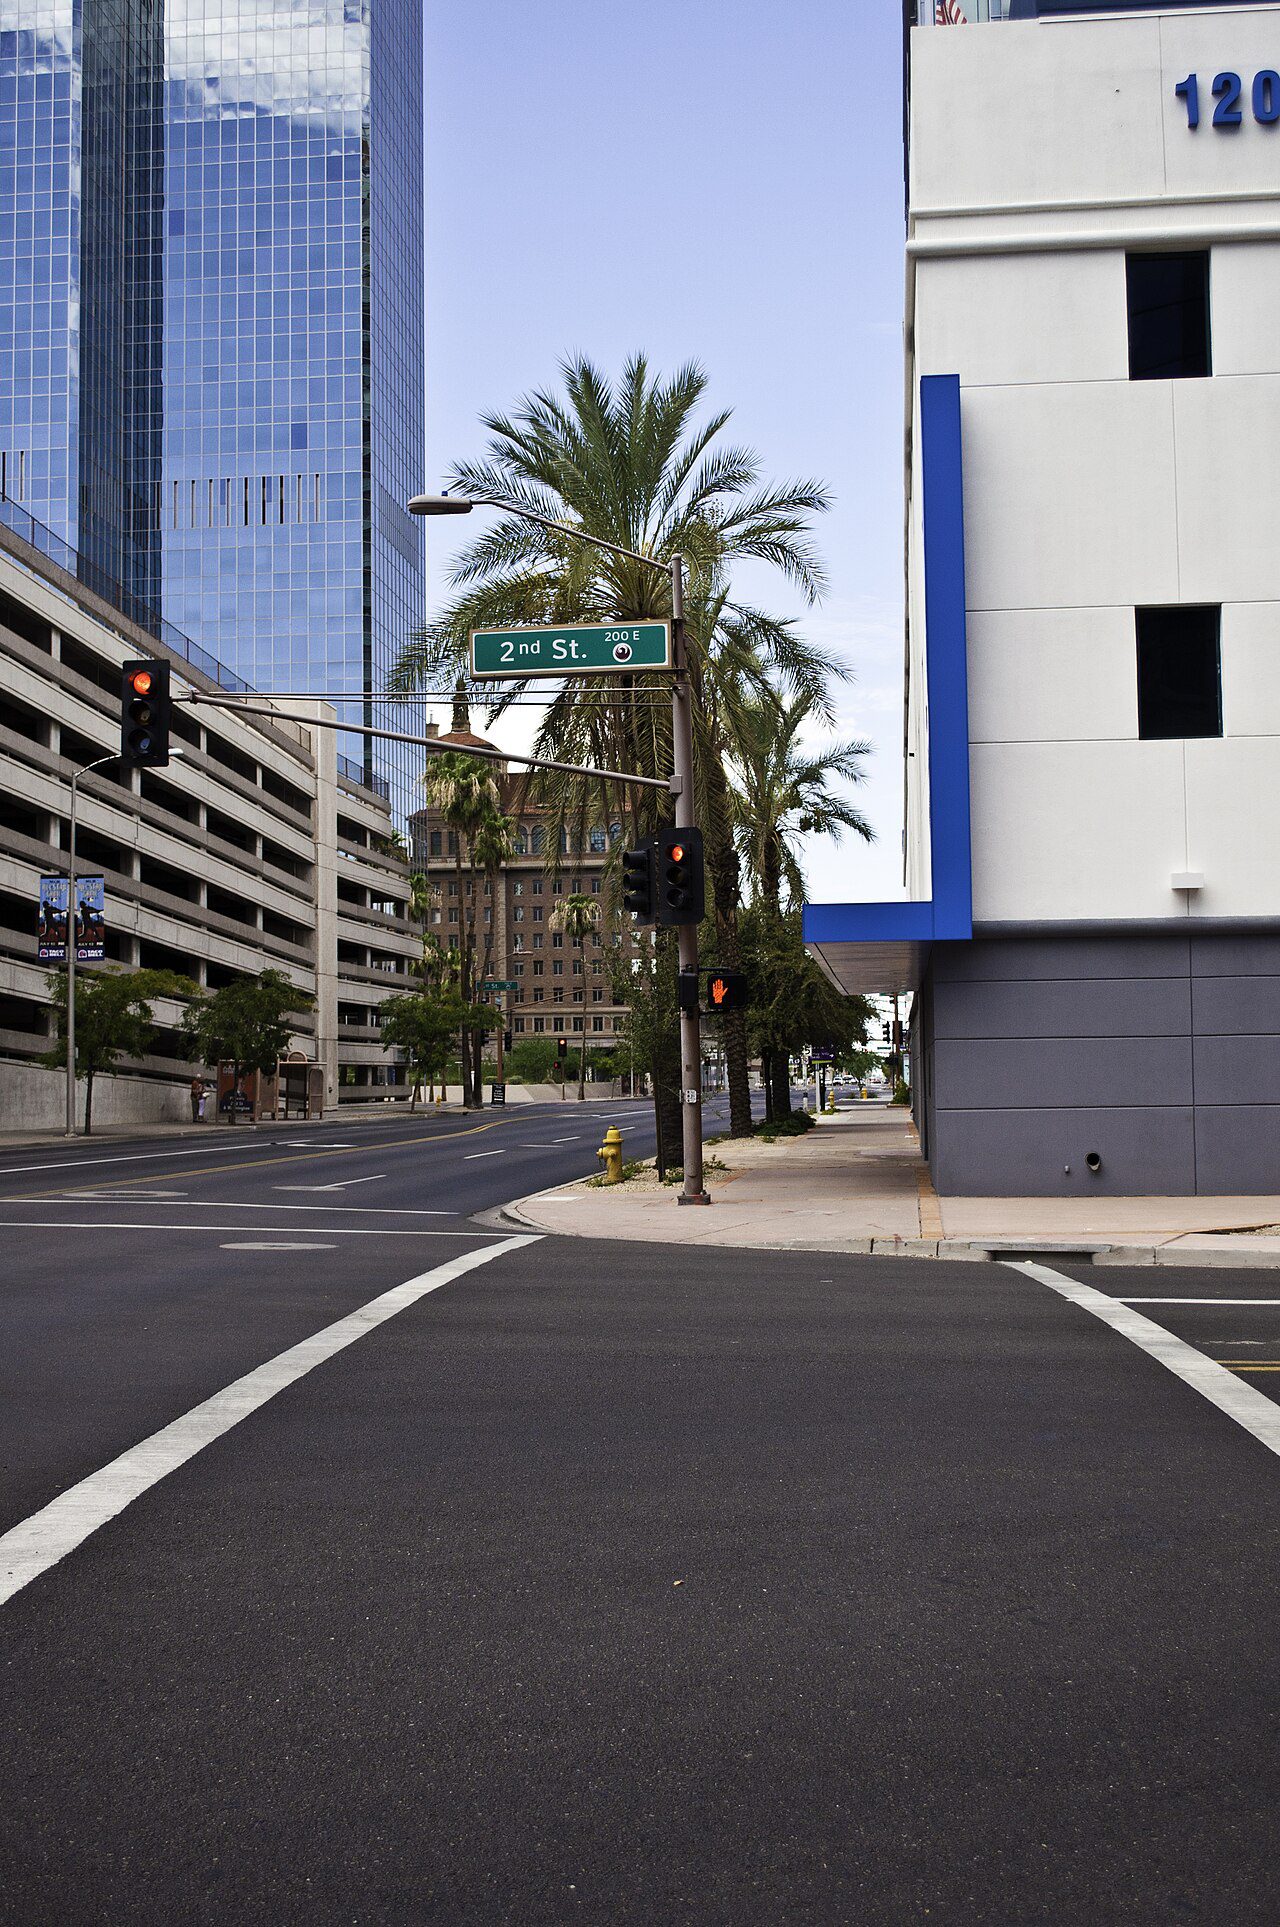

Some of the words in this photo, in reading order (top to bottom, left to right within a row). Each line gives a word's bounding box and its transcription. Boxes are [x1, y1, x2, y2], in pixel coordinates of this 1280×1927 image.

[1175, 69, 1280, 128] 120
[604, 631, 629, 642] 200
[633, 630, 640, 640] E
[500, 640, 541, 662] 2nd
[552, 639, 587, 660] St.
